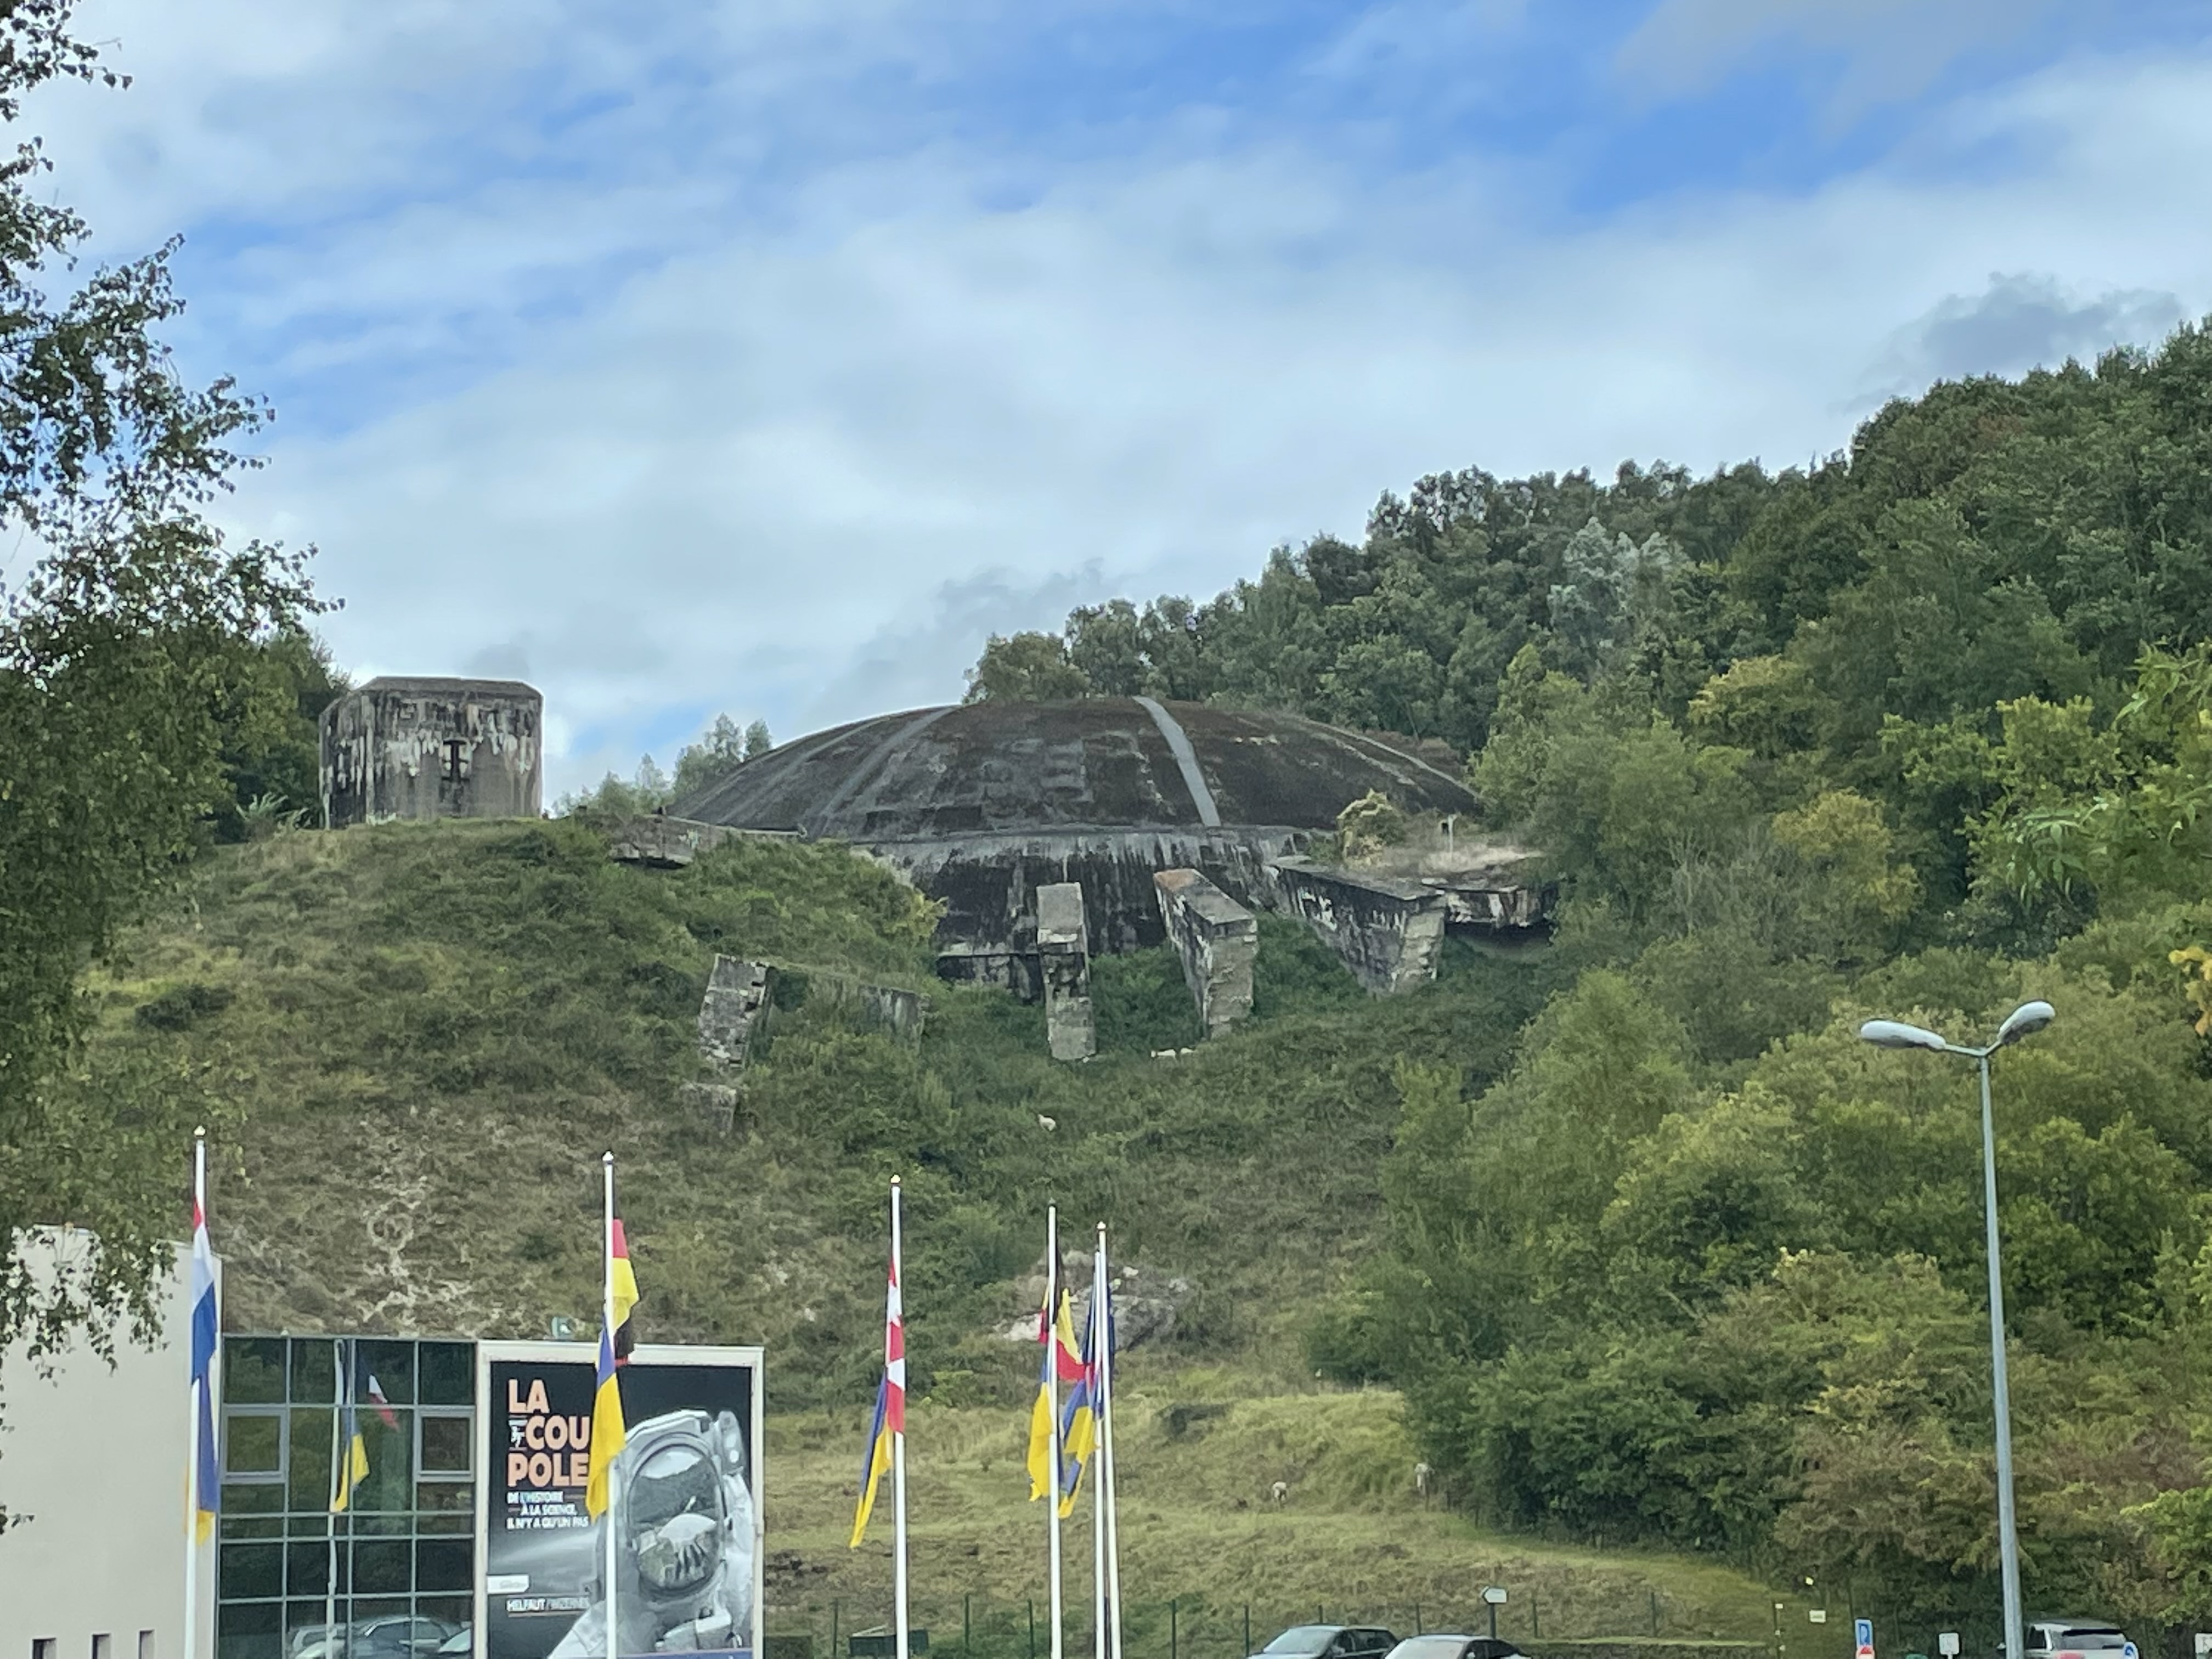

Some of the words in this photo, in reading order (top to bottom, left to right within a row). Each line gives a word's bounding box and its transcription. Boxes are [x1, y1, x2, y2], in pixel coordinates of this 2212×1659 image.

[509, 1379, 549, 1413] LA
[526, 1415, 590, 1450] COU
[508, 1453, 589, 1487] POLE
